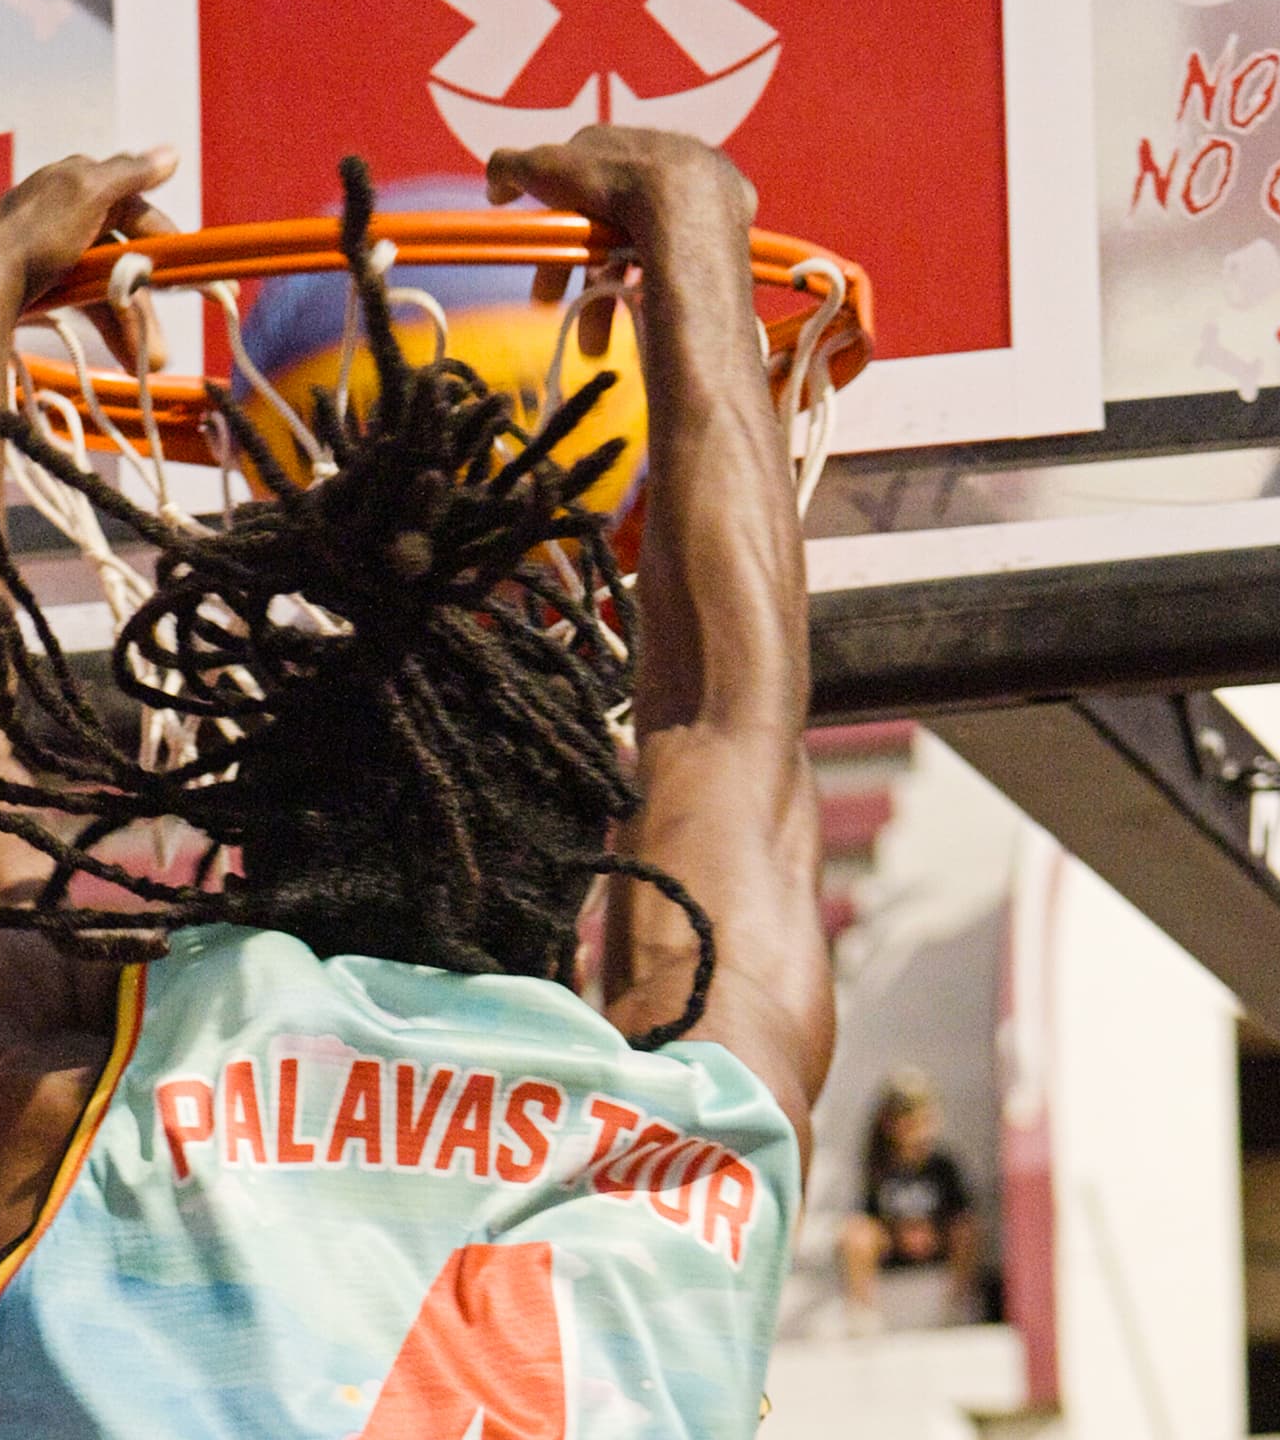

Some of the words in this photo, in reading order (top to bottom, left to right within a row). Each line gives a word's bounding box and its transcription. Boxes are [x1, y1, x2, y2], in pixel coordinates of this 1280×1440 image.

[1130, 137, 1234, 215] NO
[156, 1056, 568, 1185] PALAVAS
[571, 1096, 760, 1266] TOUR
